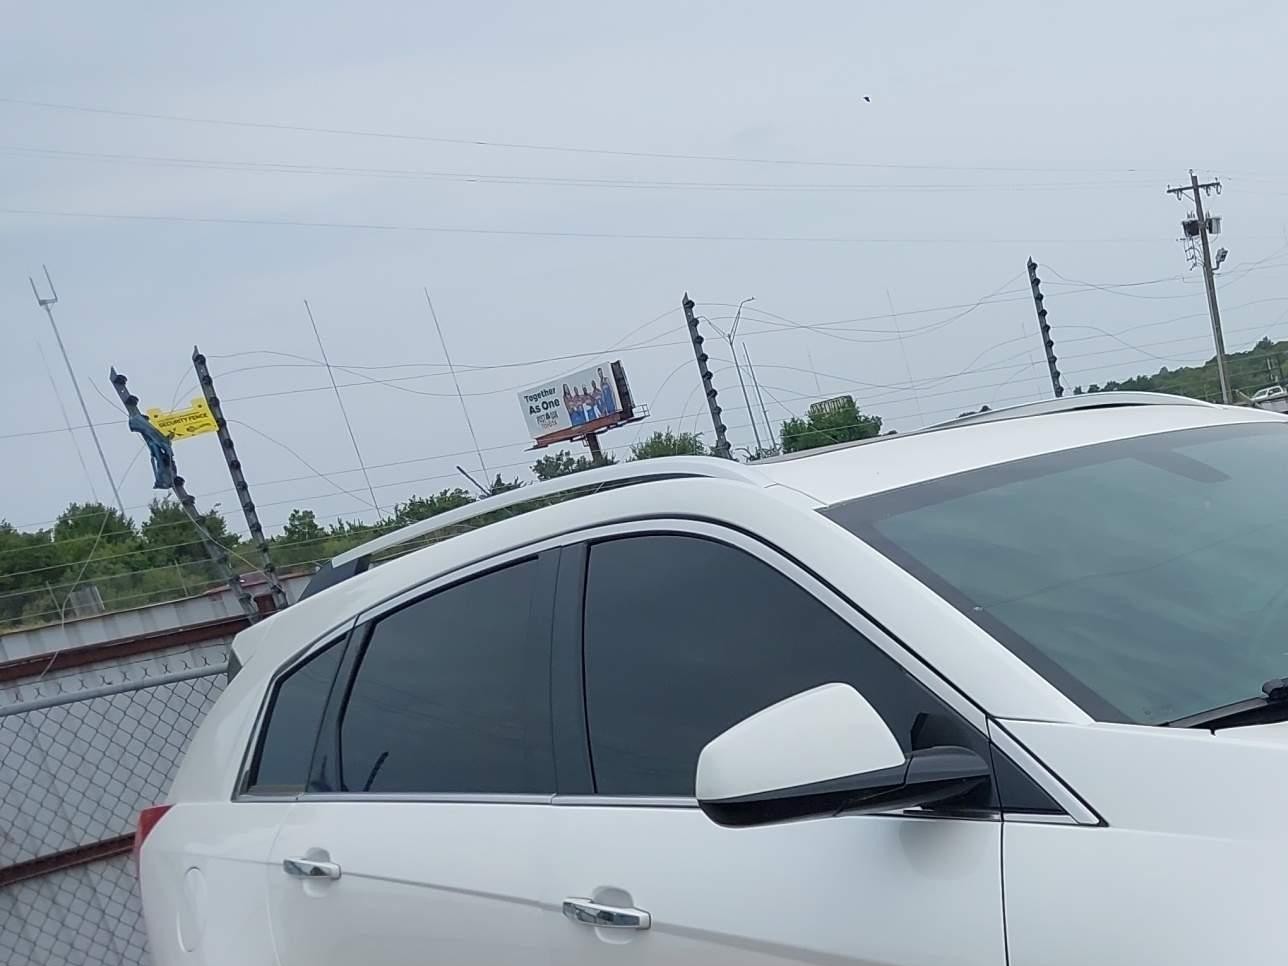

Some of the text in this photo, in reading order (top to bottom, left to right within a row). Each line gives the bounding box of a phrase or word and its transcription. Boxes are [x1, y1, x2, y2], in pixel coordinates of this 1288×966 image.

[524, 388, 556, 402] Together
[529, 398, 560, 415] As One
[158, 417, 188, 428] SECURITY
[189, 413, 208, 421] FENCE
